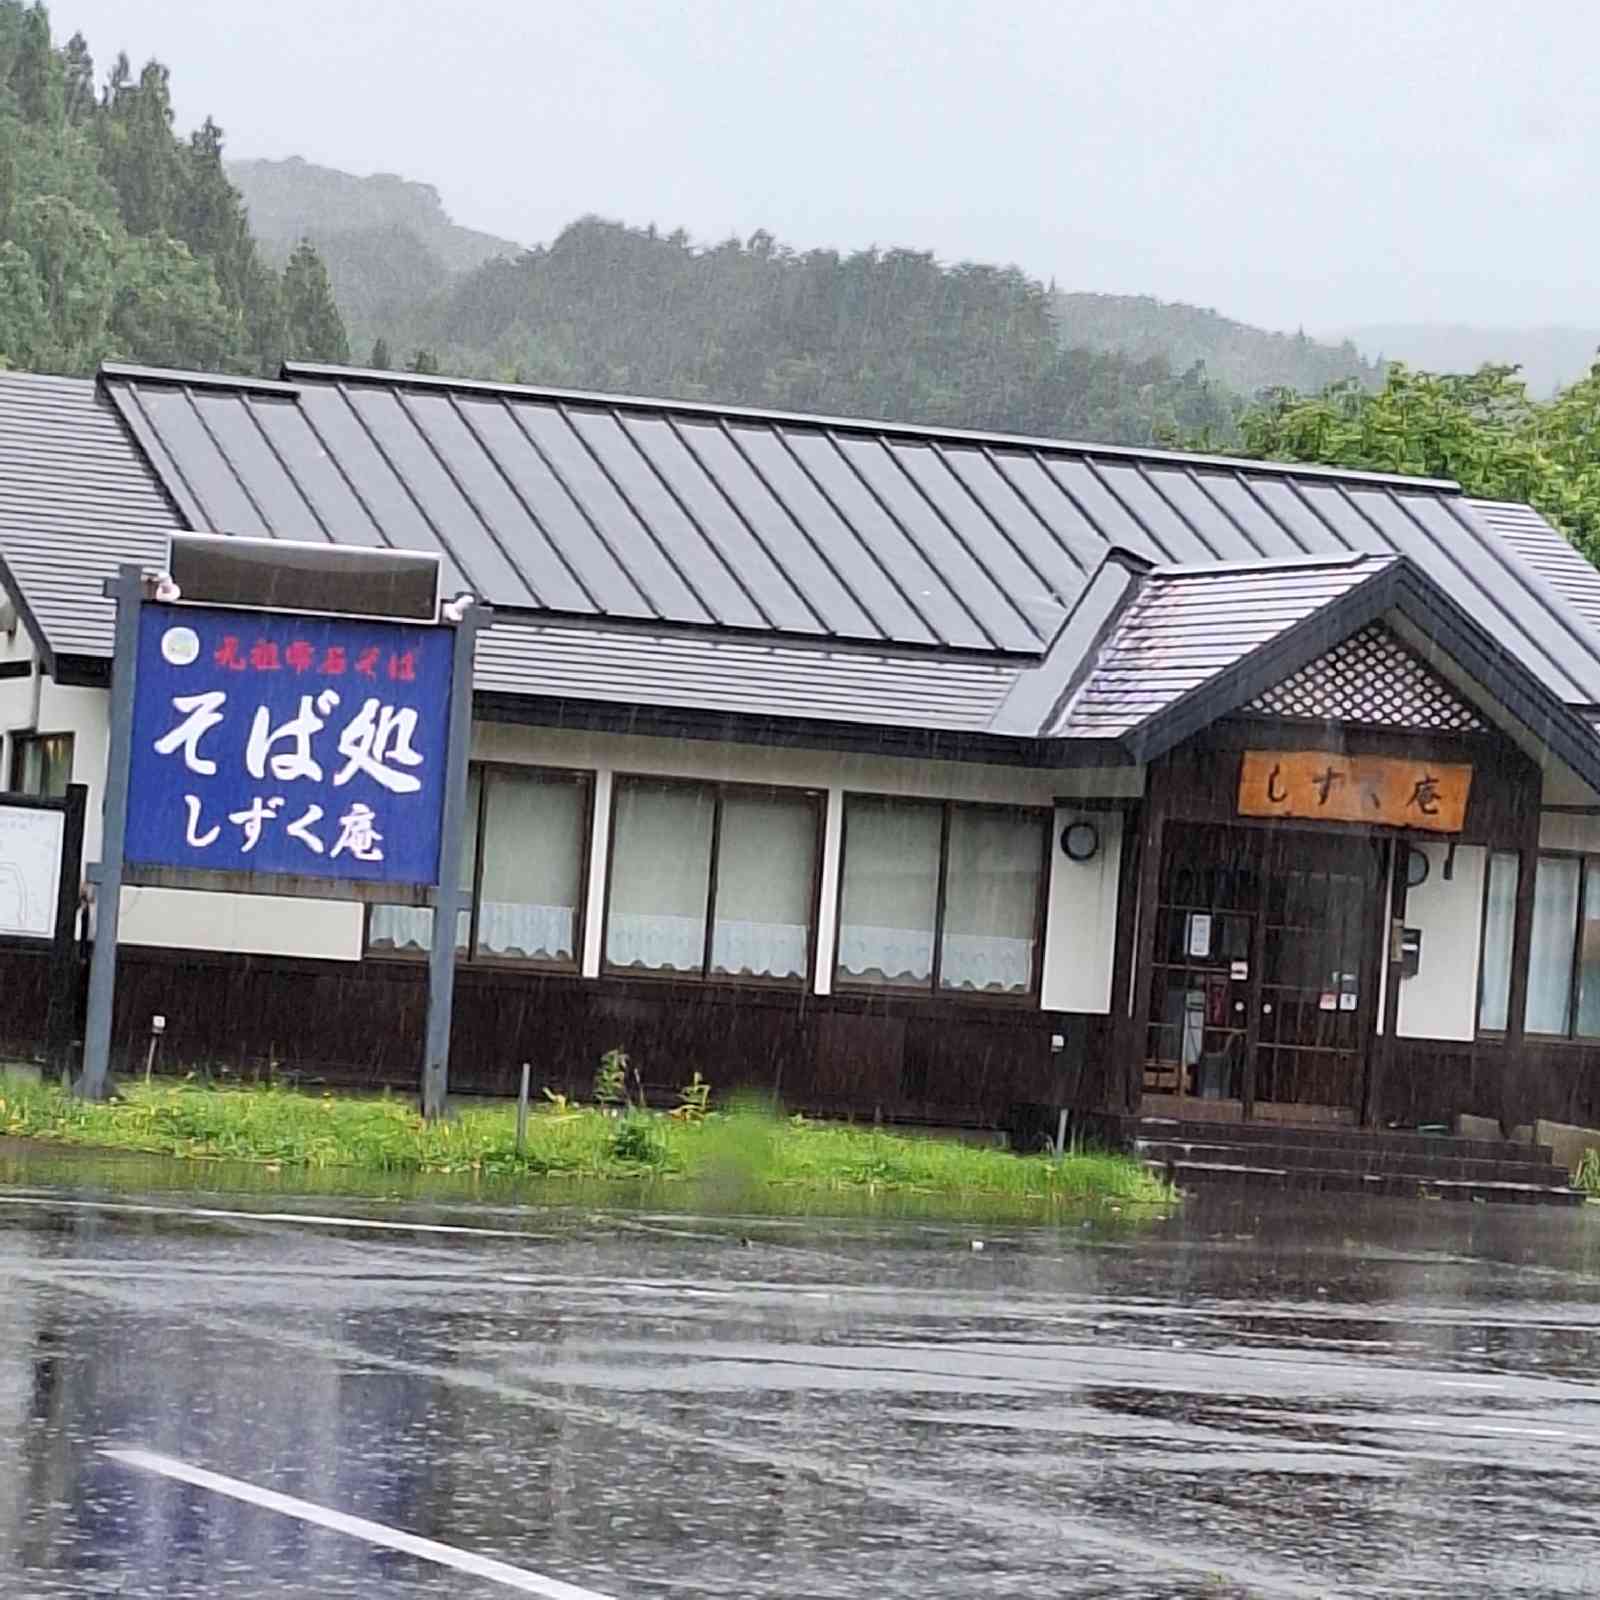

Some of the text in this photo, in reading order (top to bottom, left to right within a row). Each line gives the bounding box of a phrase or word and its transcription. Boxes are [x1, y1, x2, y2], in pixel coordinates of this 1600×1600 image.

[154, 689, 424, 793] そば処
[184, 794, 384, 861] しずく庵
